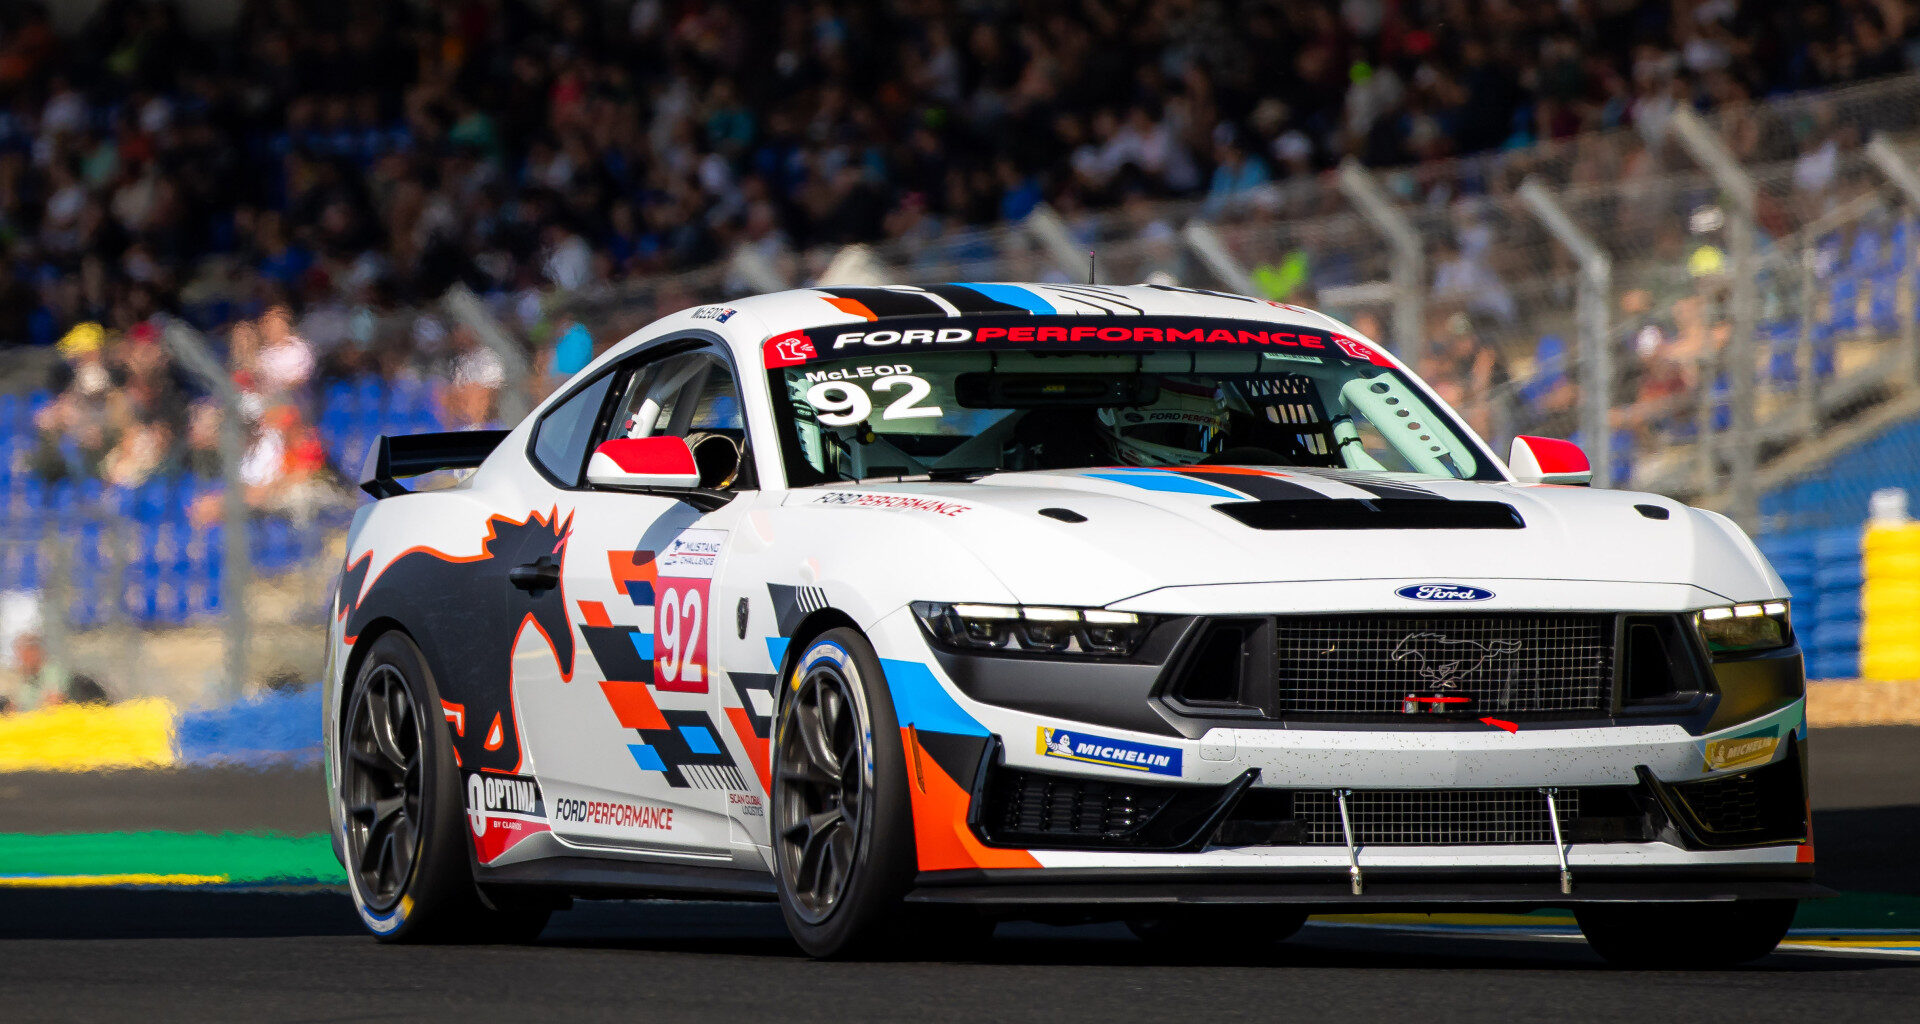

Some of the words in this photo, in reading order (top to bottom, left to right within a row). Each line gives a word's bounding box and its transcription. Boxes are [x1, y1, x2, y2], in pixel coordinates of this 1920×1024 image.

[805, 364, 913, 383] McLEOD
[806, 374, 943, 427] 92
[1149, 412, 1181, 421] FORD
[685, 541, 721, 554] MUSTANG
[680, 556, 715, 567] CHALLENGE
[1416, 586, 1475, 599] Ford
[660, 587, 703, 683] 92
[1726, 736, 1773, 759] MICHELIN
[1076, 743, 1170, 767] MICHELIN
[485, 777, 536, 813] OPTIMA
[729, 793, 745, 804] SCAN
[741, 805, 764, 816] LOGISTICS
[493, 820, 501, 828] BY
[502, 821, 522, 831] CLARIOS
